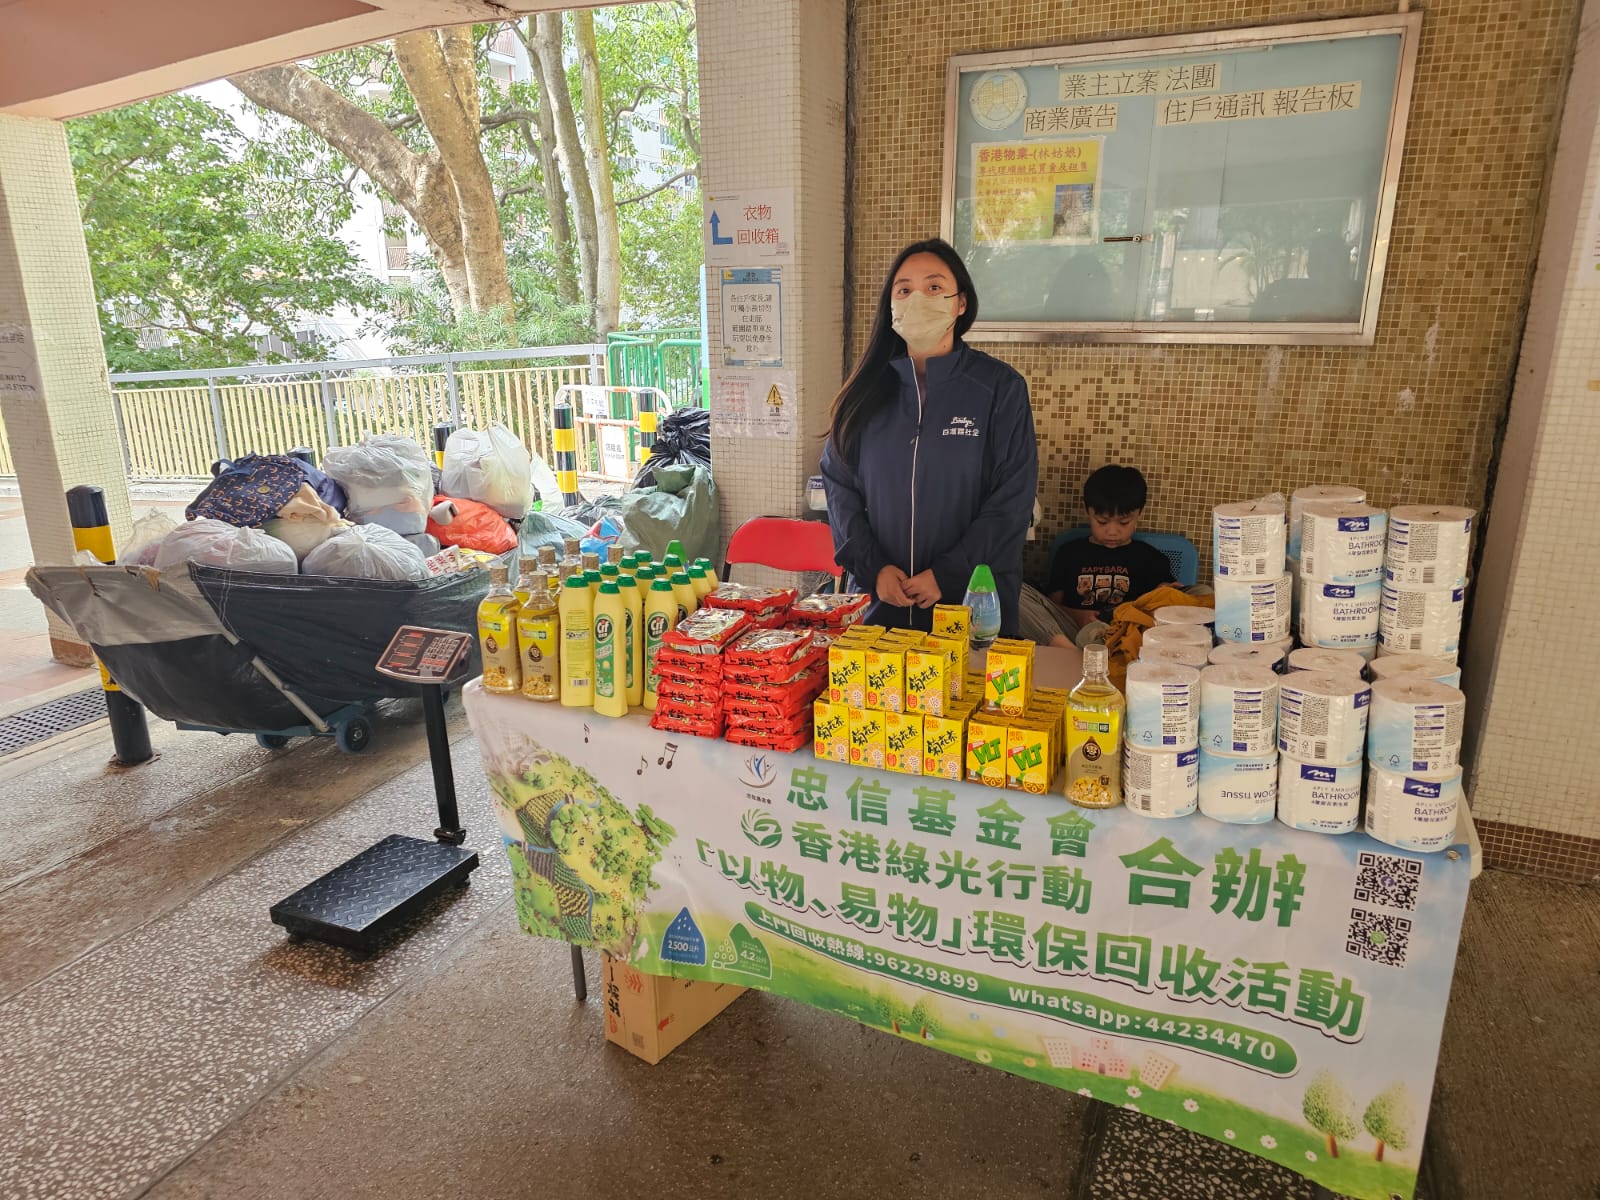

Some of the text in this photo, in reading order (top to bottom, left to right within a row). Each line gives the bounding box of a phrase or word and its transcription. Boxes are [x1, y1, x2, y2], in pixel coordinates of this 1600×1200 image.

[1064, 63, 1216, 99] 業主立案法團
[1025, 104, 1117, 133] 商業廣告
[1165, 84, 1355, 125] 住戶通訊報告板
[743, 204, 772, 221] 衣物
[737, 228, 779, 245] 回收箱
[597, 619, 610, 633] Cif
[651, 616, 664, 631] Cif
[832, 660, 861, 687] 菊花茶
[868, 664, 898, 690] 菊花茶
[908, 664, 939, 693] 菊花茶
[991, 666, 1020, 695] VLT
[816, 715, 845, 740] 菊花茶
[851, 720, 881, 746] 菊花茶
[888, 725, 918, 751] 菊花茶
[927, 730, 958, 756] 菊花茶
[972, 738, 1002, 766] VLT
[1013, 742, 1043, 772] VLT
[1220, 790, 1251, 800] TISSUE
[787, 765, 1096, 858] 忠信基金會
[792, 820, 1092, 914] 香港綠光行動
[1118, 837, 1307, 927] 合辦
[696, 837, 1366, 1037] 「以物、易物」環保回收活動
[1008, 985, 1277, 1061] Whatsapp:44234470
